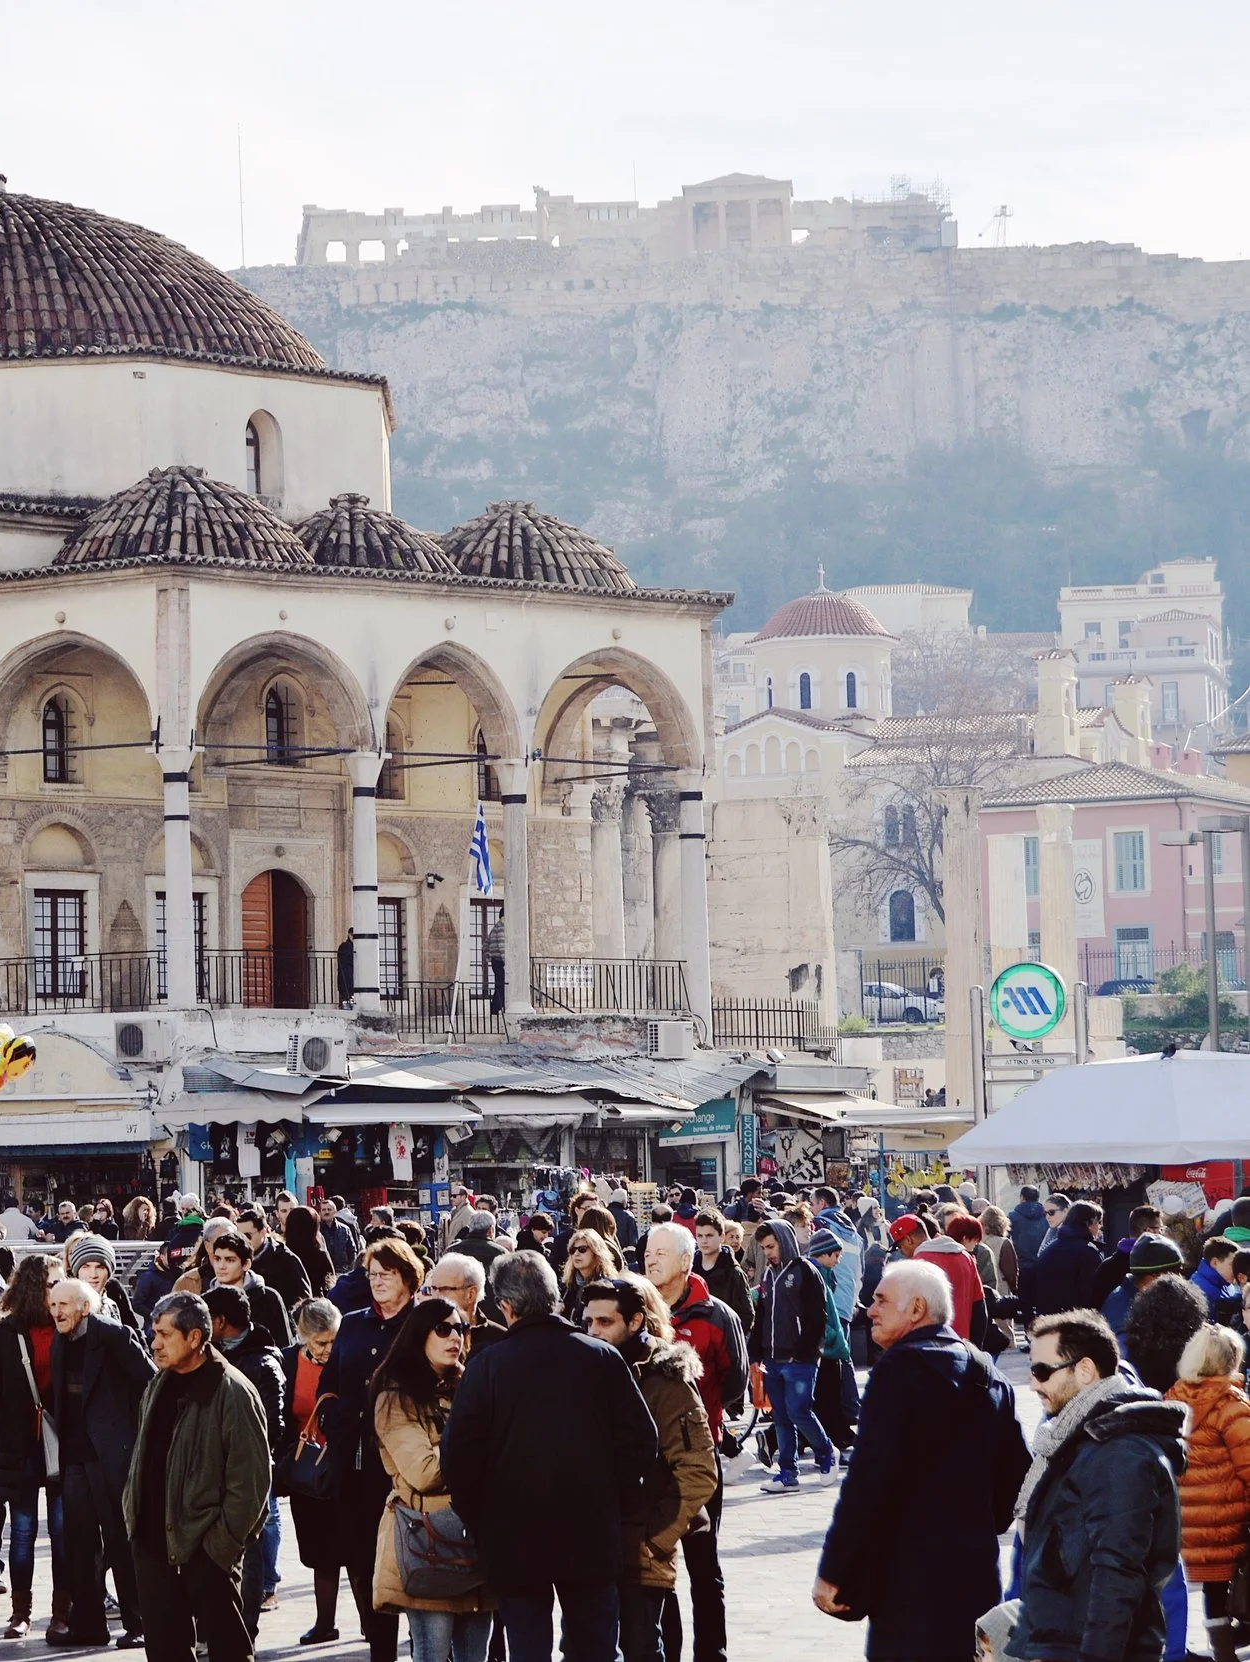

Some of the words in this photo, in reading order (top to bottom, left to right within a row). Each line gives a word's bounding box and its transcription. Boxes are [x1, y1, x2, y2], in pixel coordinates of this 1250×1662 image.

[126, 1124, 138, 1134] 97
[715, 1124, 731, 1132] change
[743, 1115, 752, 1174] EXCHANGE
